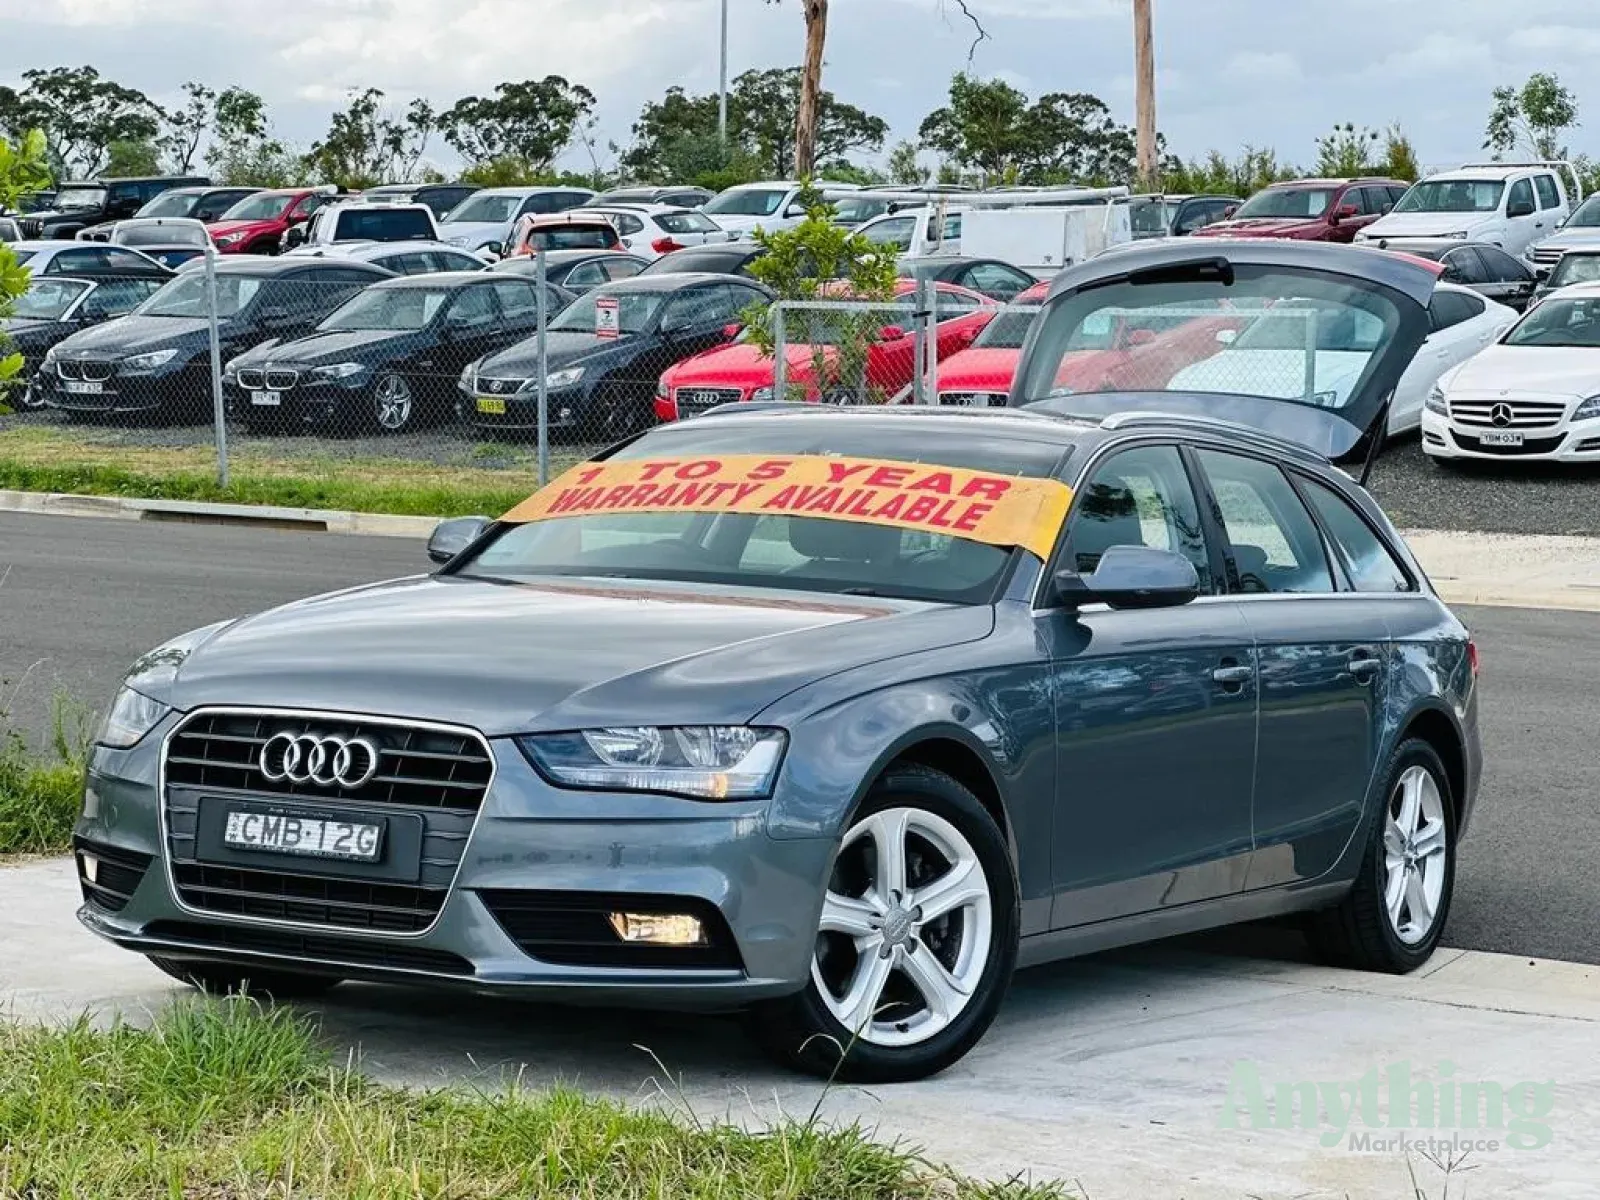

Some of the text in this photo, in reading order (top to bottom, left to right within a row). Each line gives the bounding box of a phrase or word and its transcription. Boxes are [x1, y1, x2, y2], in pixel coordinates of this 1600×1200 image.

[576, 460, 1013, 501] 1 TO 5 YEAR
[546, 482, 994, 532] WARRANTY AVAILABLE
